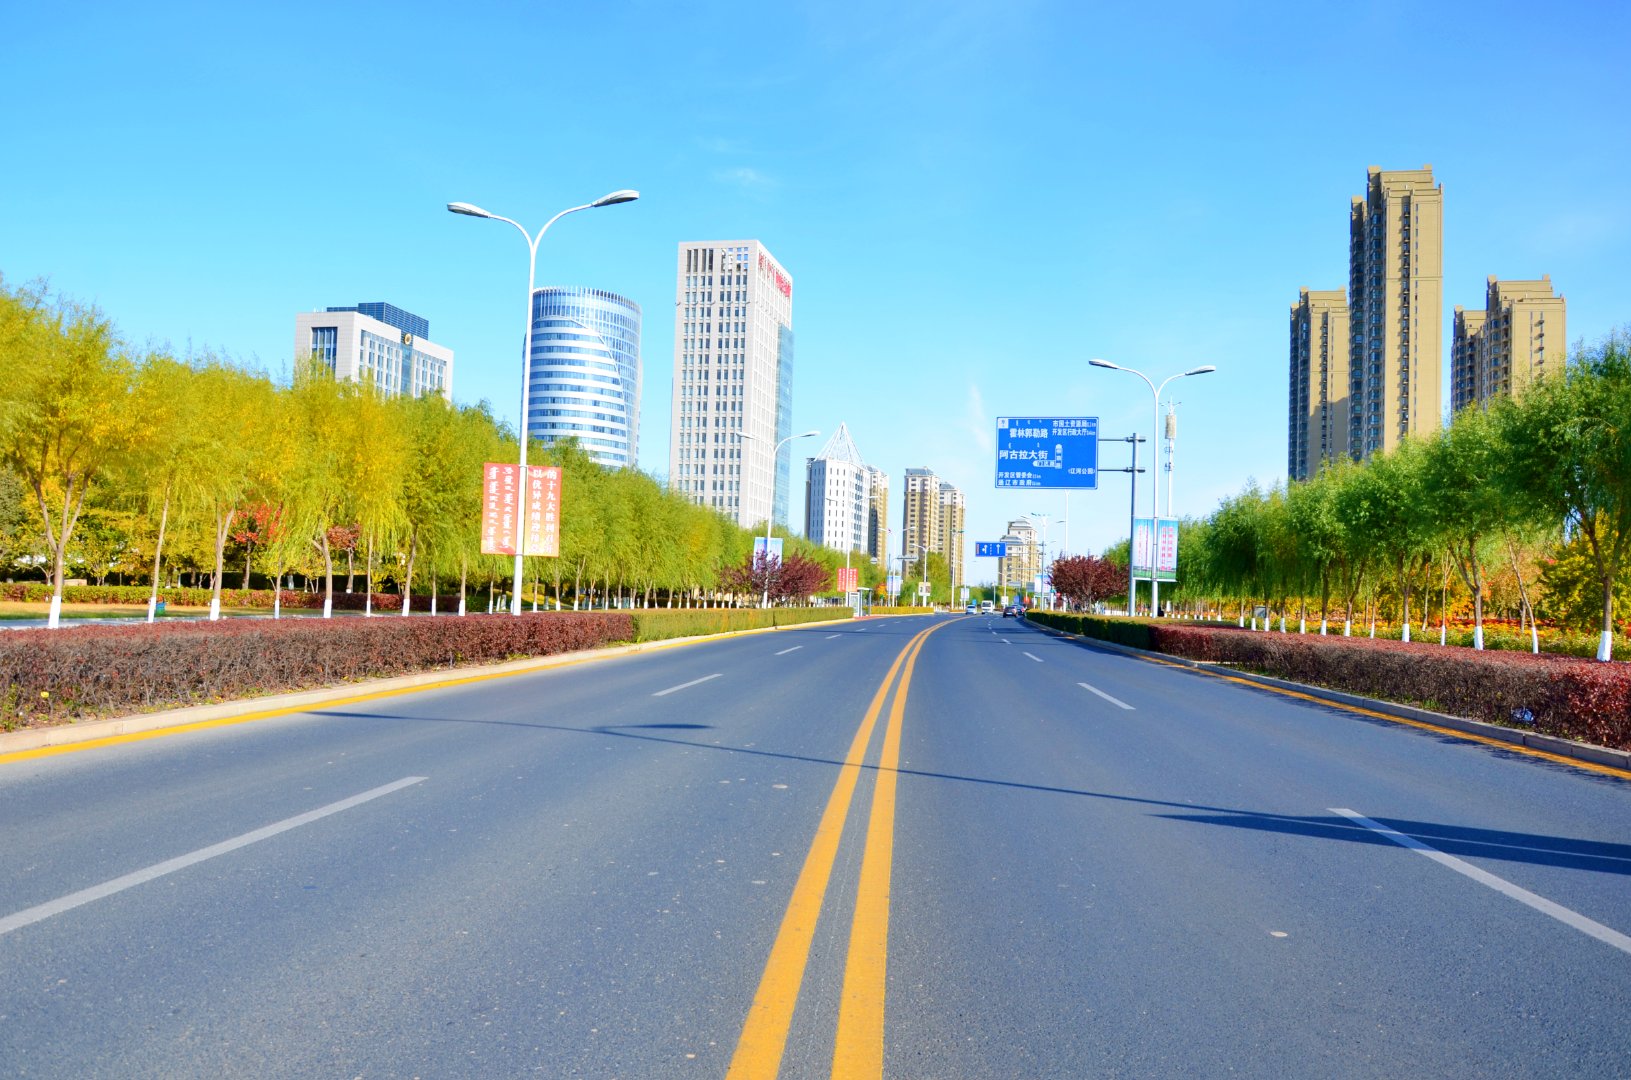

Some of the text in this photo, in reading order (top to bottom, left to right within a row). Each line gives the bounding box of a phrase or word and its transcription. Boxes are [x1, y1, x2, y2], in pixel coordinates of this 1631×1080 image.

[1009, 427, 1049, 438] 霍林郭勒路
[999, 450, 1048, 460] 阿古拉大街
[998, 471, 1032, 479] 开发区管委会
